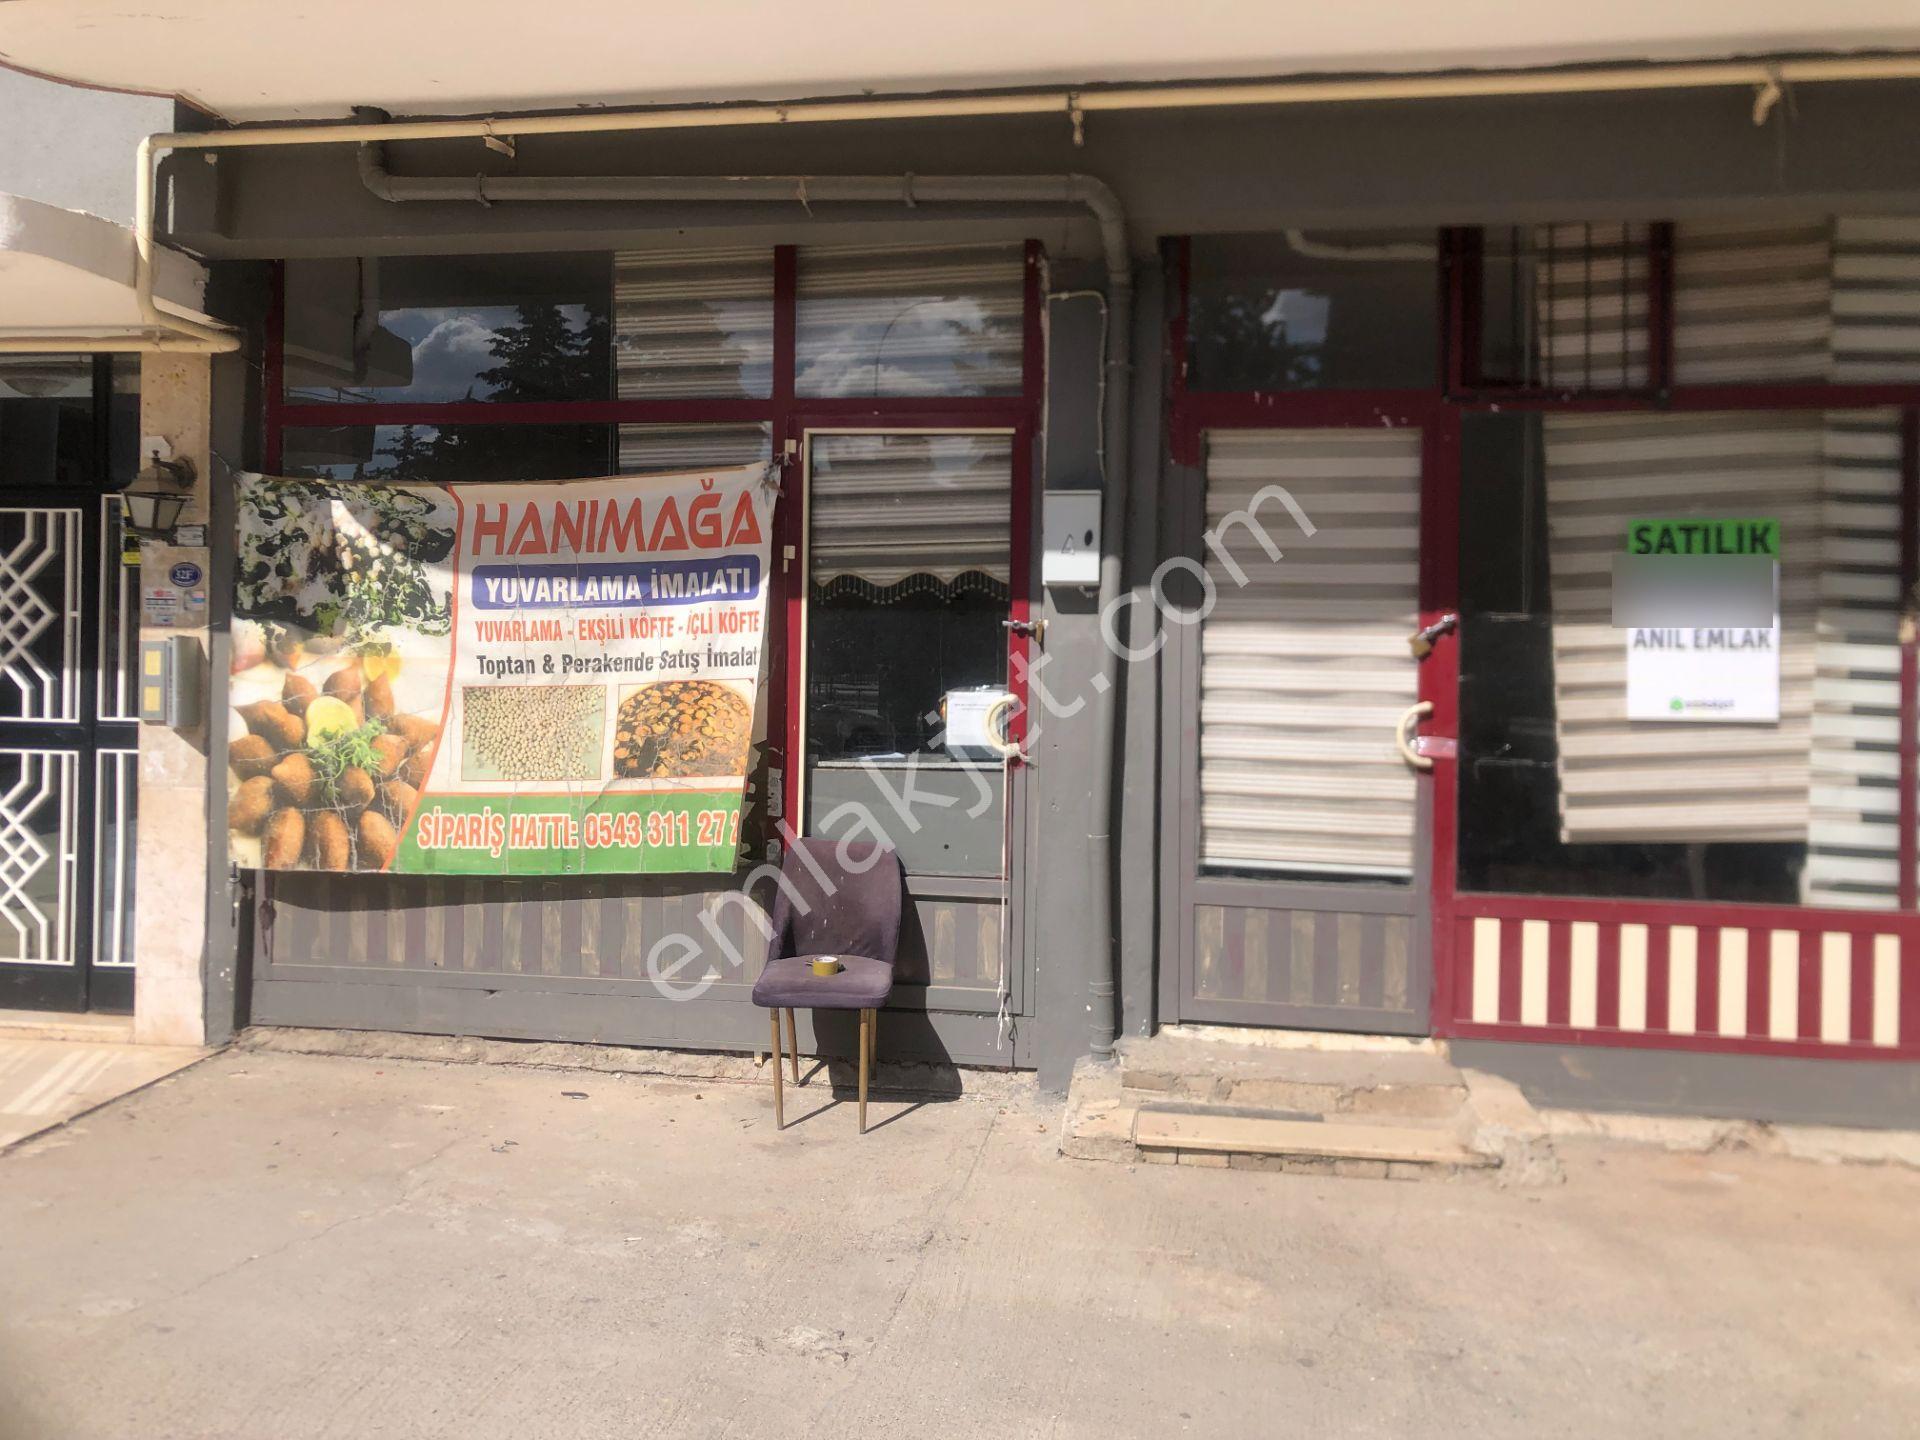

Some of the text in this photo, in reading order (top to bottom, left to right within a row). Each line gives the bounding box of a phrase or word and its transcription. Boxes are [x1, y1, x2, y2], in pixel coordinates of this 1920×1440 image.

[472, 478, 762, 555] HANIMAĞA
[1634, 523, 1772, 555] SATILIK
[484, 567, 751, 603] YUVARLAMA İMALATI
[475, 619, 563, 643] YUVARLAMA
[578, 613, 625, 647] EKŞİLİ
[630, 611, 675, 640] KÖFTE
[686, 609, 713, 637] İÇLİ
[718, 606, 760, 634] KÖFTE
[1633, 628, 1772, 649] ANIL EMLAK
[476, 654, 536, 680] Toptan
[542, 653, 555, 674] &
[562, 649, 654, 674] Perakende
[658, 648, 700, 674] Satış
[417, 806, 505, 858] SİPARİŞ
[508, 814, 579, 849] HATTI:
[584, 811, 643, 848] 0543
[648, 810, 689, 847] 311
[696, 810, 727, 846] 27
